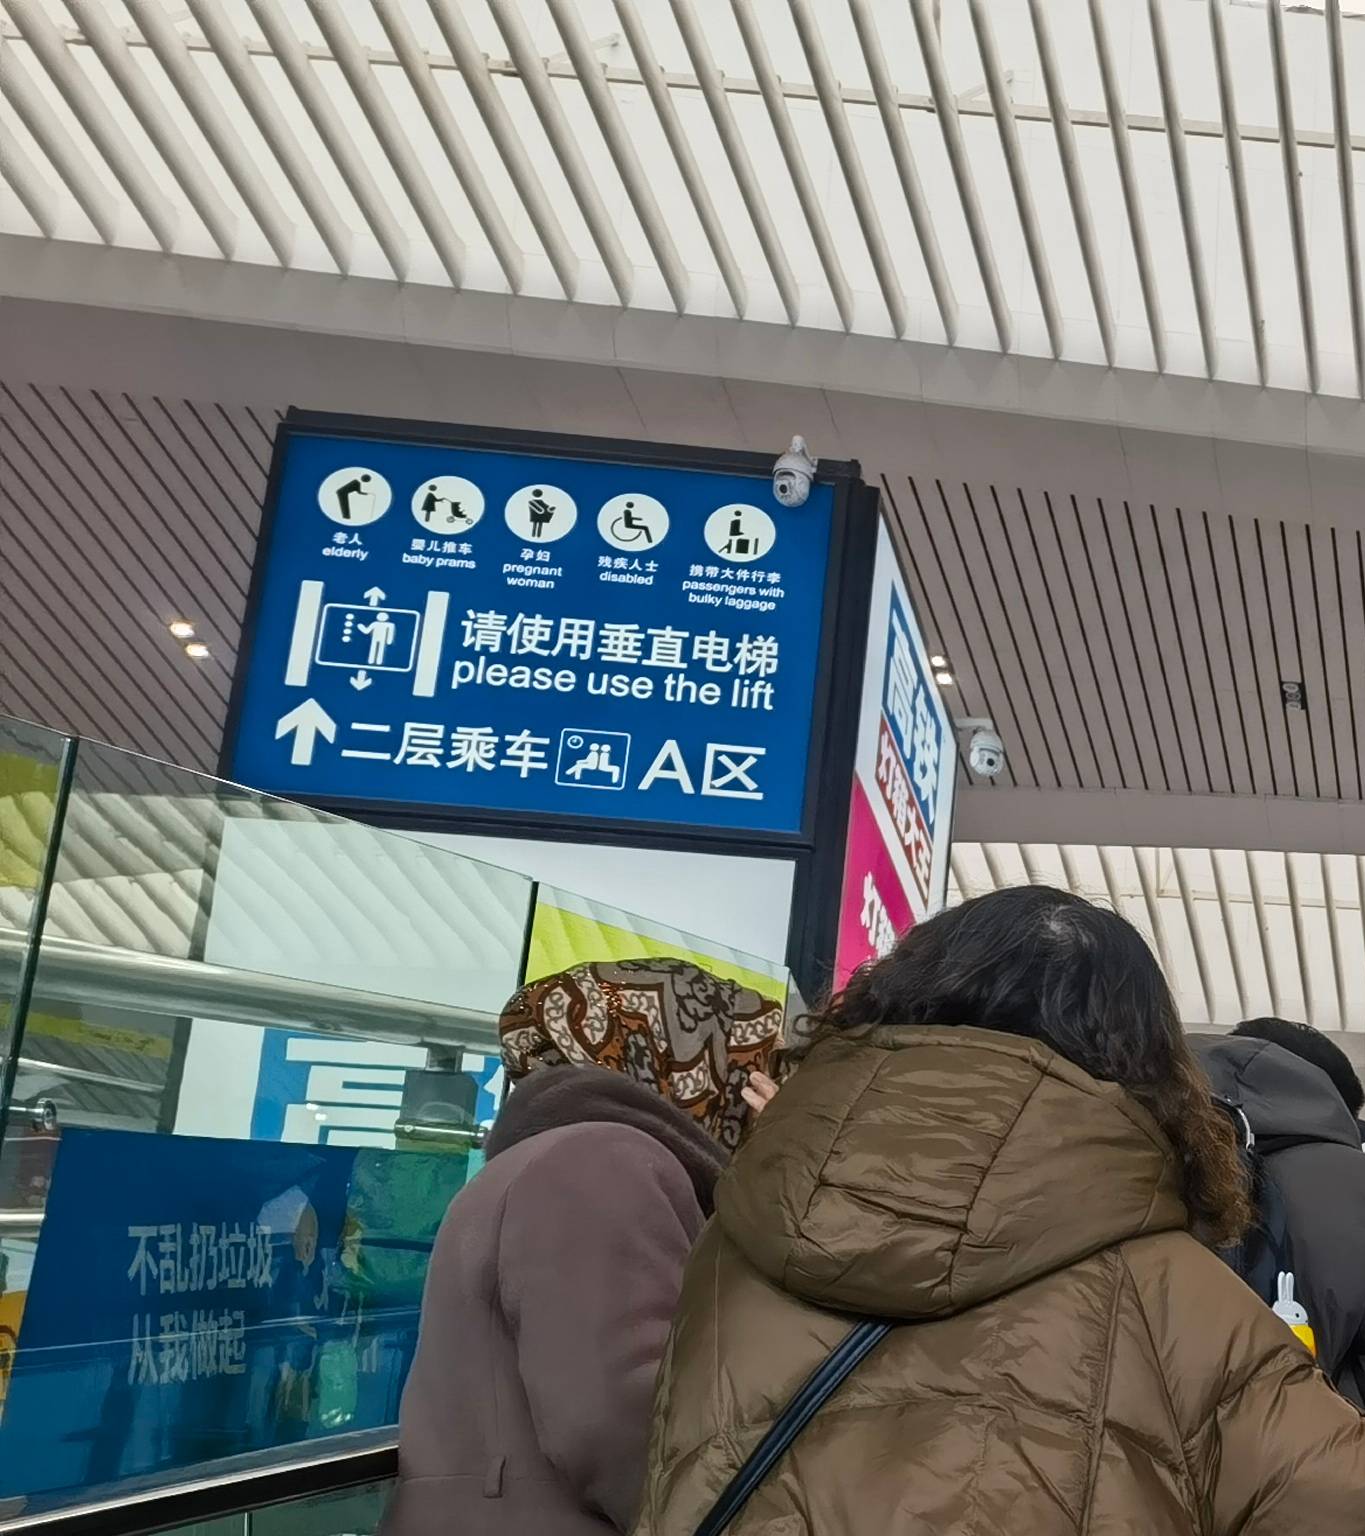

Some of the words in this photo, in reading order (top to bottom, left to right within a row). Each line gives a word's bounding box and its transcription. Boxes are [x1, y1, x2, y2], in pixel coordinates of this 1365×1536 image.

[332, 531, 363, 545] 老人
[410, 538, 473, 555] 婴儿推车
[321, 545, 368, 561] elderly
[402, 552, 434, 568] baby
[435, 555, 476, 570] prams
[519, 548, 551, 562] 孕妇
[502, 561, 562, 578] pregnant
[597, 555, 659, 573] 残疾人士
[506, 576, 555, 590] woman
[599, 570, 654, 586] disabled
[689, 563, 782, 585] 携带大件行李
[682, 578, 757, 596] passengers
[758, 585, 785, 599] with
[688, 592, 723, 608] bulky
[459, 608, 780, 678] 请使用垂直电梯
[451, 656, 577, 692] please
[586, 671, 654, 700] use
[663, 672, 721, 706] the
[730, 679, 775, 711] lift
[341, 721, 551, 779] 二层乘车
[637, 738, 767, 801] A区
[127, 1221, 274, 1297] 不乱扔垃圾
[127, 1308, 247, 1386] 从我做起
